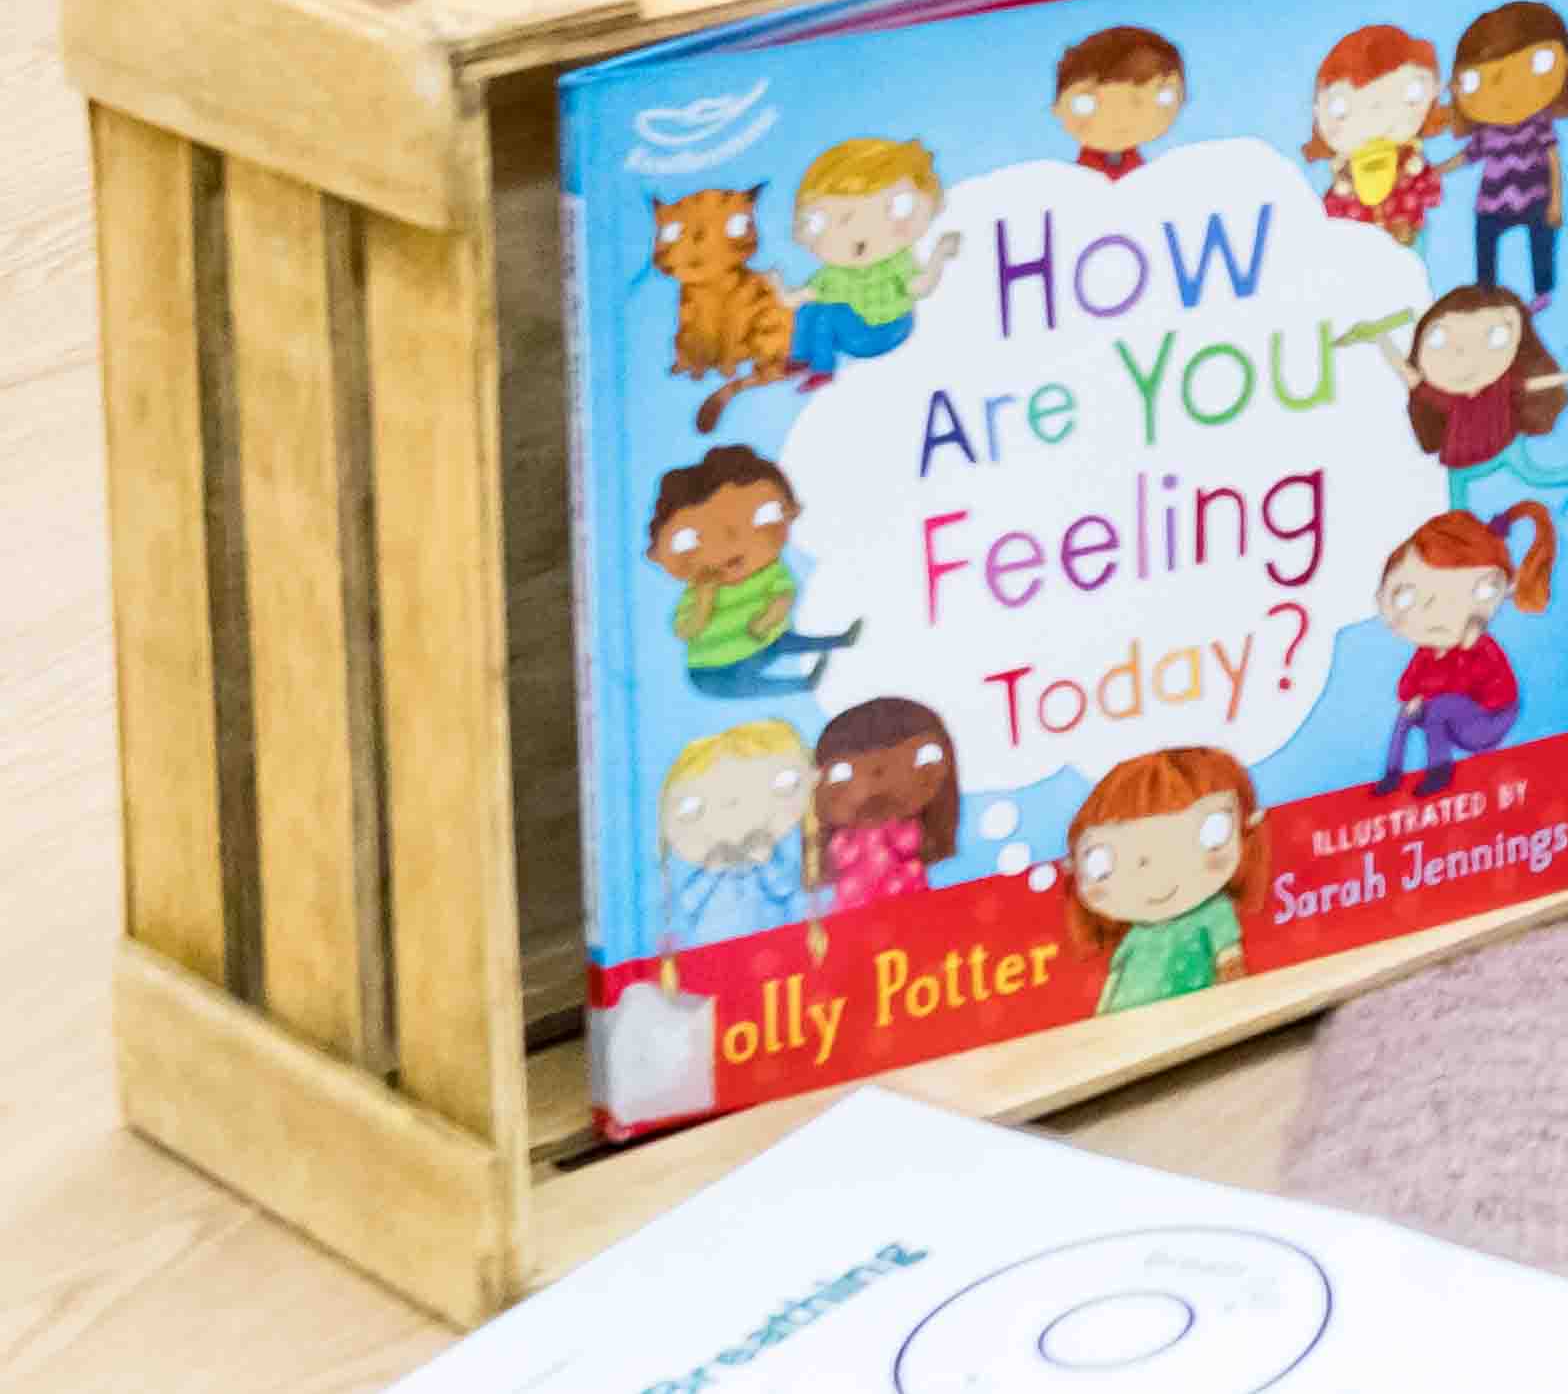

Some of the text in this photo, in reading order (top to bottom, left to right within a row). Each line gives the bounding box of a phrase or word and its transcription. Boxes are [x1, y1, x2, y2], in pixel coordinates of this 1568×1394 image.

[995, 201, 1277, 338] How
[917, 317, 1340, 479] Are You
[917, 465, 1329, 626] Feeling
[984, 600, 1312, 750] Today?
[1273, 845, 1389, 926] Sarah
[1311, 778, 1531, 857] ILLUSTRATED BY
[721, 940, 1060, 1067] olly Potter
